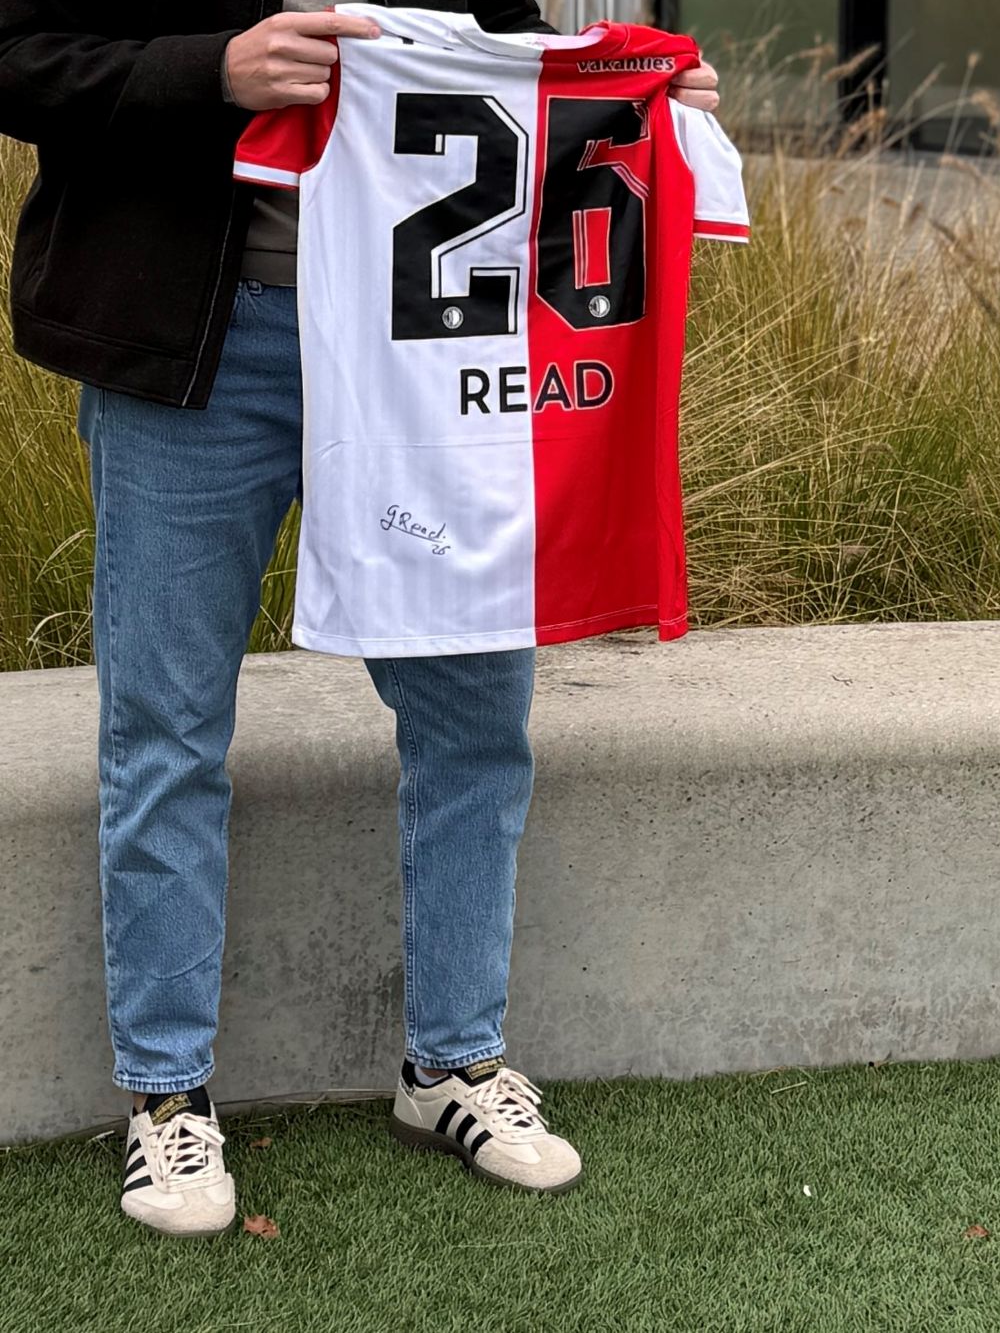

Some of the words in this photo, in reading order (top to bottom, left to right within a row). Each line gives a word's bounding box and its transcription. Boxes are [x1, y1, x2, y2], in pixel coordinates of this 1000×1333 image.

[576, 56, 676, 73] vakanties
[391, 92, 650, 340] 26
[460, 360, 614, 415] READ
